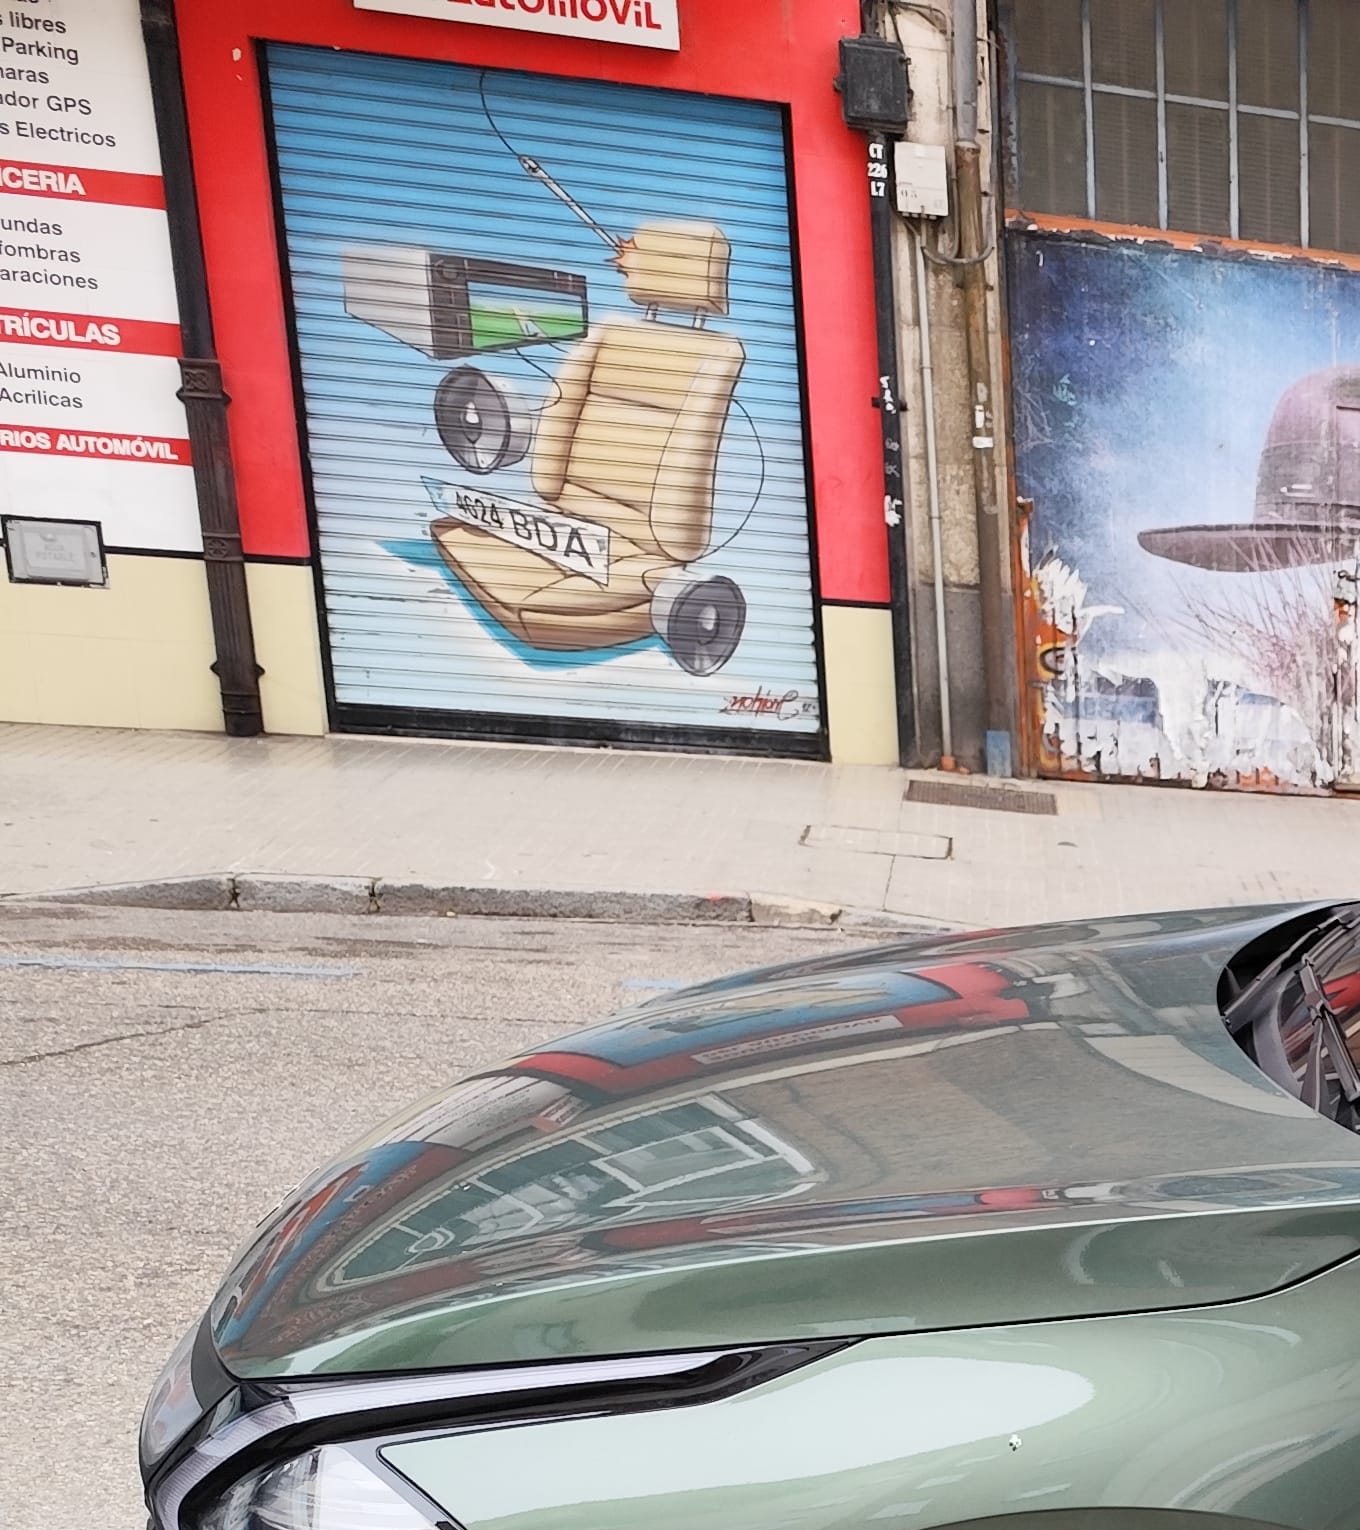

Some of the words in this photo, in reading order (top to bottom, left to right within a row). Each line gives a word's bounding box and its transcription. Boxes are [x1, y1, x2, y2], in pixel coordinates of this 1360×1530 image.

[9, 11, 67, 34] libres
[2, 36, 79, 66] Parking
[47, 95, 92, 116] GPS
[15, 120, 116, 148] Electricos
[55, 433, 179, 461] AUTOMÓVIL
[509, 508, 594, 569] BDA
